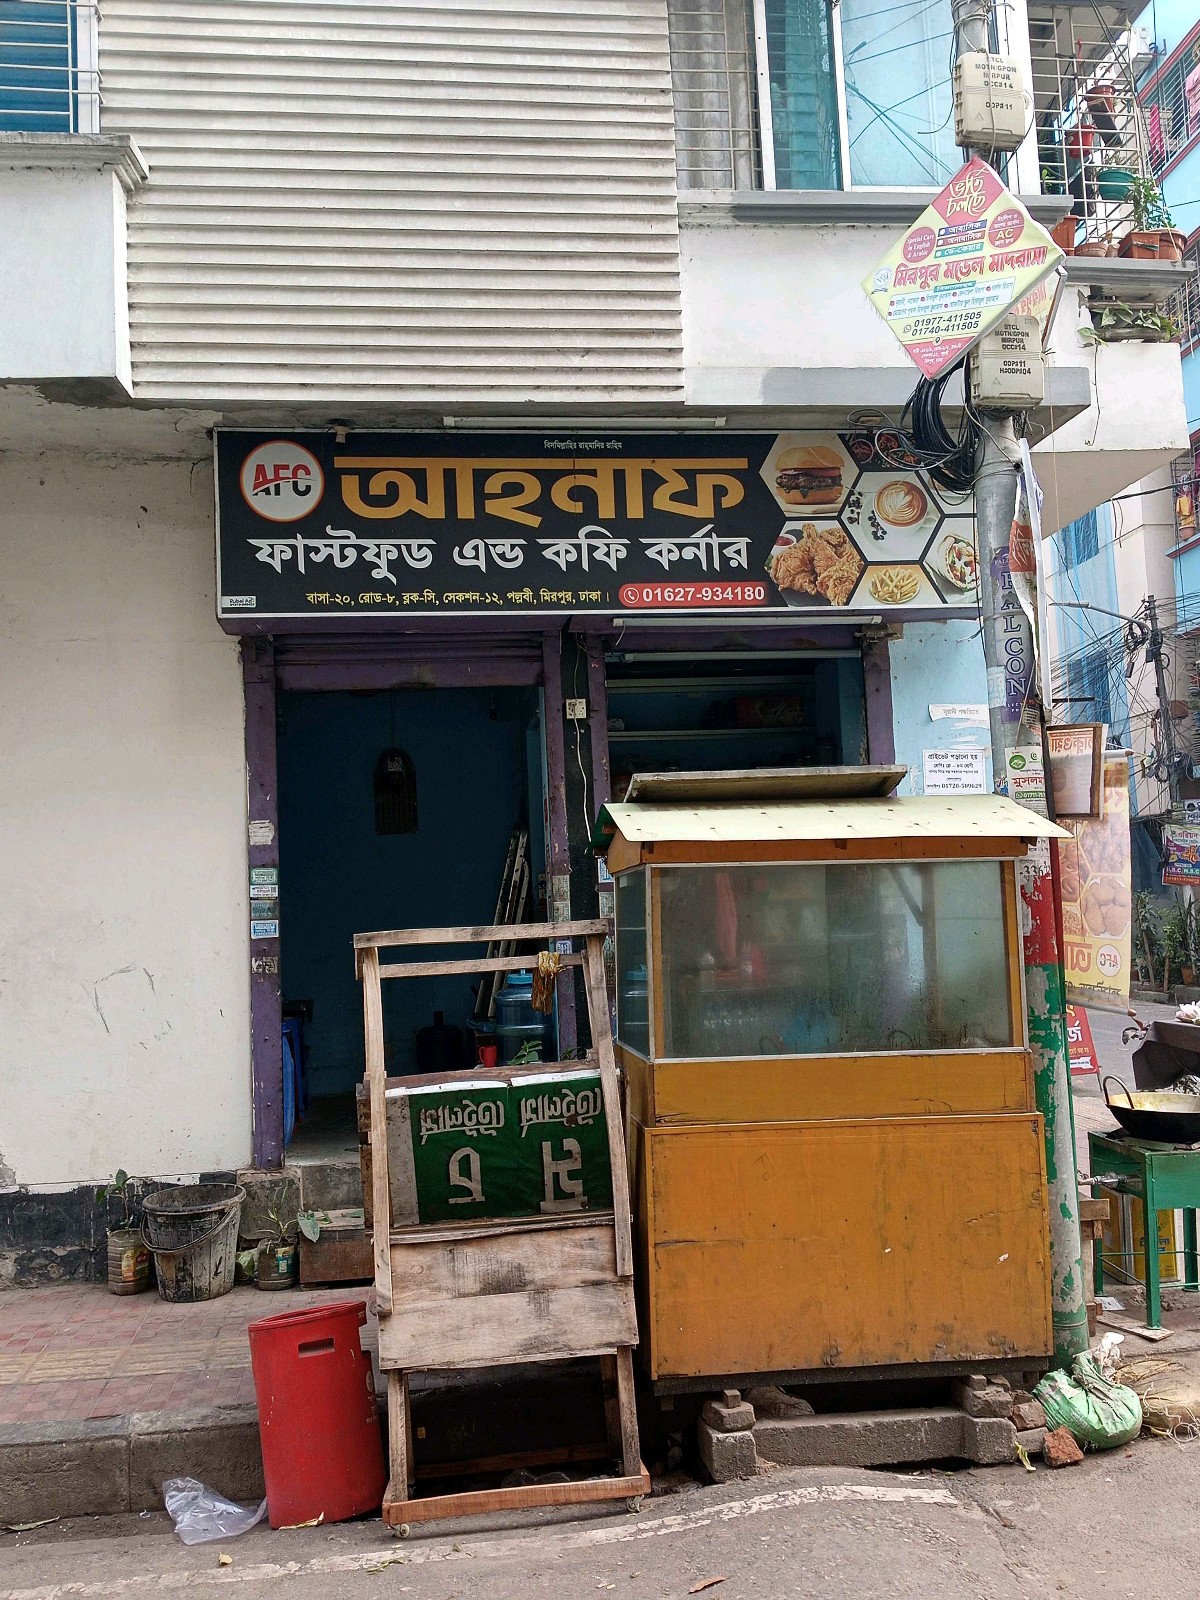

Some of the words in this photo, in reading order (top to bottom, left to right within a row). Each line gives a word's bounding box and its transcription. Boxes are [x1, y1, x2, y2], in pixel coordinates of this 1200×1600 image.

[946, 191, 987, 217] চলছে
[996, 228, 1014, 241] AC
[893, 262, 941, 290] মিরপুর
[943, 256, 986, 282] মডেল
[989, 245, 1048, 272] মাদরাসা
[911, 320, 980, 336] 01740-411505
[914, 311, 982, 328] 01977-411505
[252, 464, 312, 497] AFC
[333, 456, 748, 528] আহনাফ
[246, 525, 437, 585] ফাস্টফুড
[453, 538, 528, 574] এন্ড
[535, 525, 631, 572] কফি
[638, 524, 752, 571] কর্নার
[305, 591, 355, 606] বাসা-২০,
[358, 591, 399, 606] রোড-৮,
[401, 588, 440, 606] ব্লক-সি,
[442, 590, 503, 606] সেকশন-১২,
[506, 588, 537, 606] পল্লবী,
[540, 588, 576, 605] মিরপুর,
[642, 586, 765, 602] 01627-934180
[1011, 776, 1045, 788] মুসলম
[419, 1099, 505, 1146] টেইলার্স
